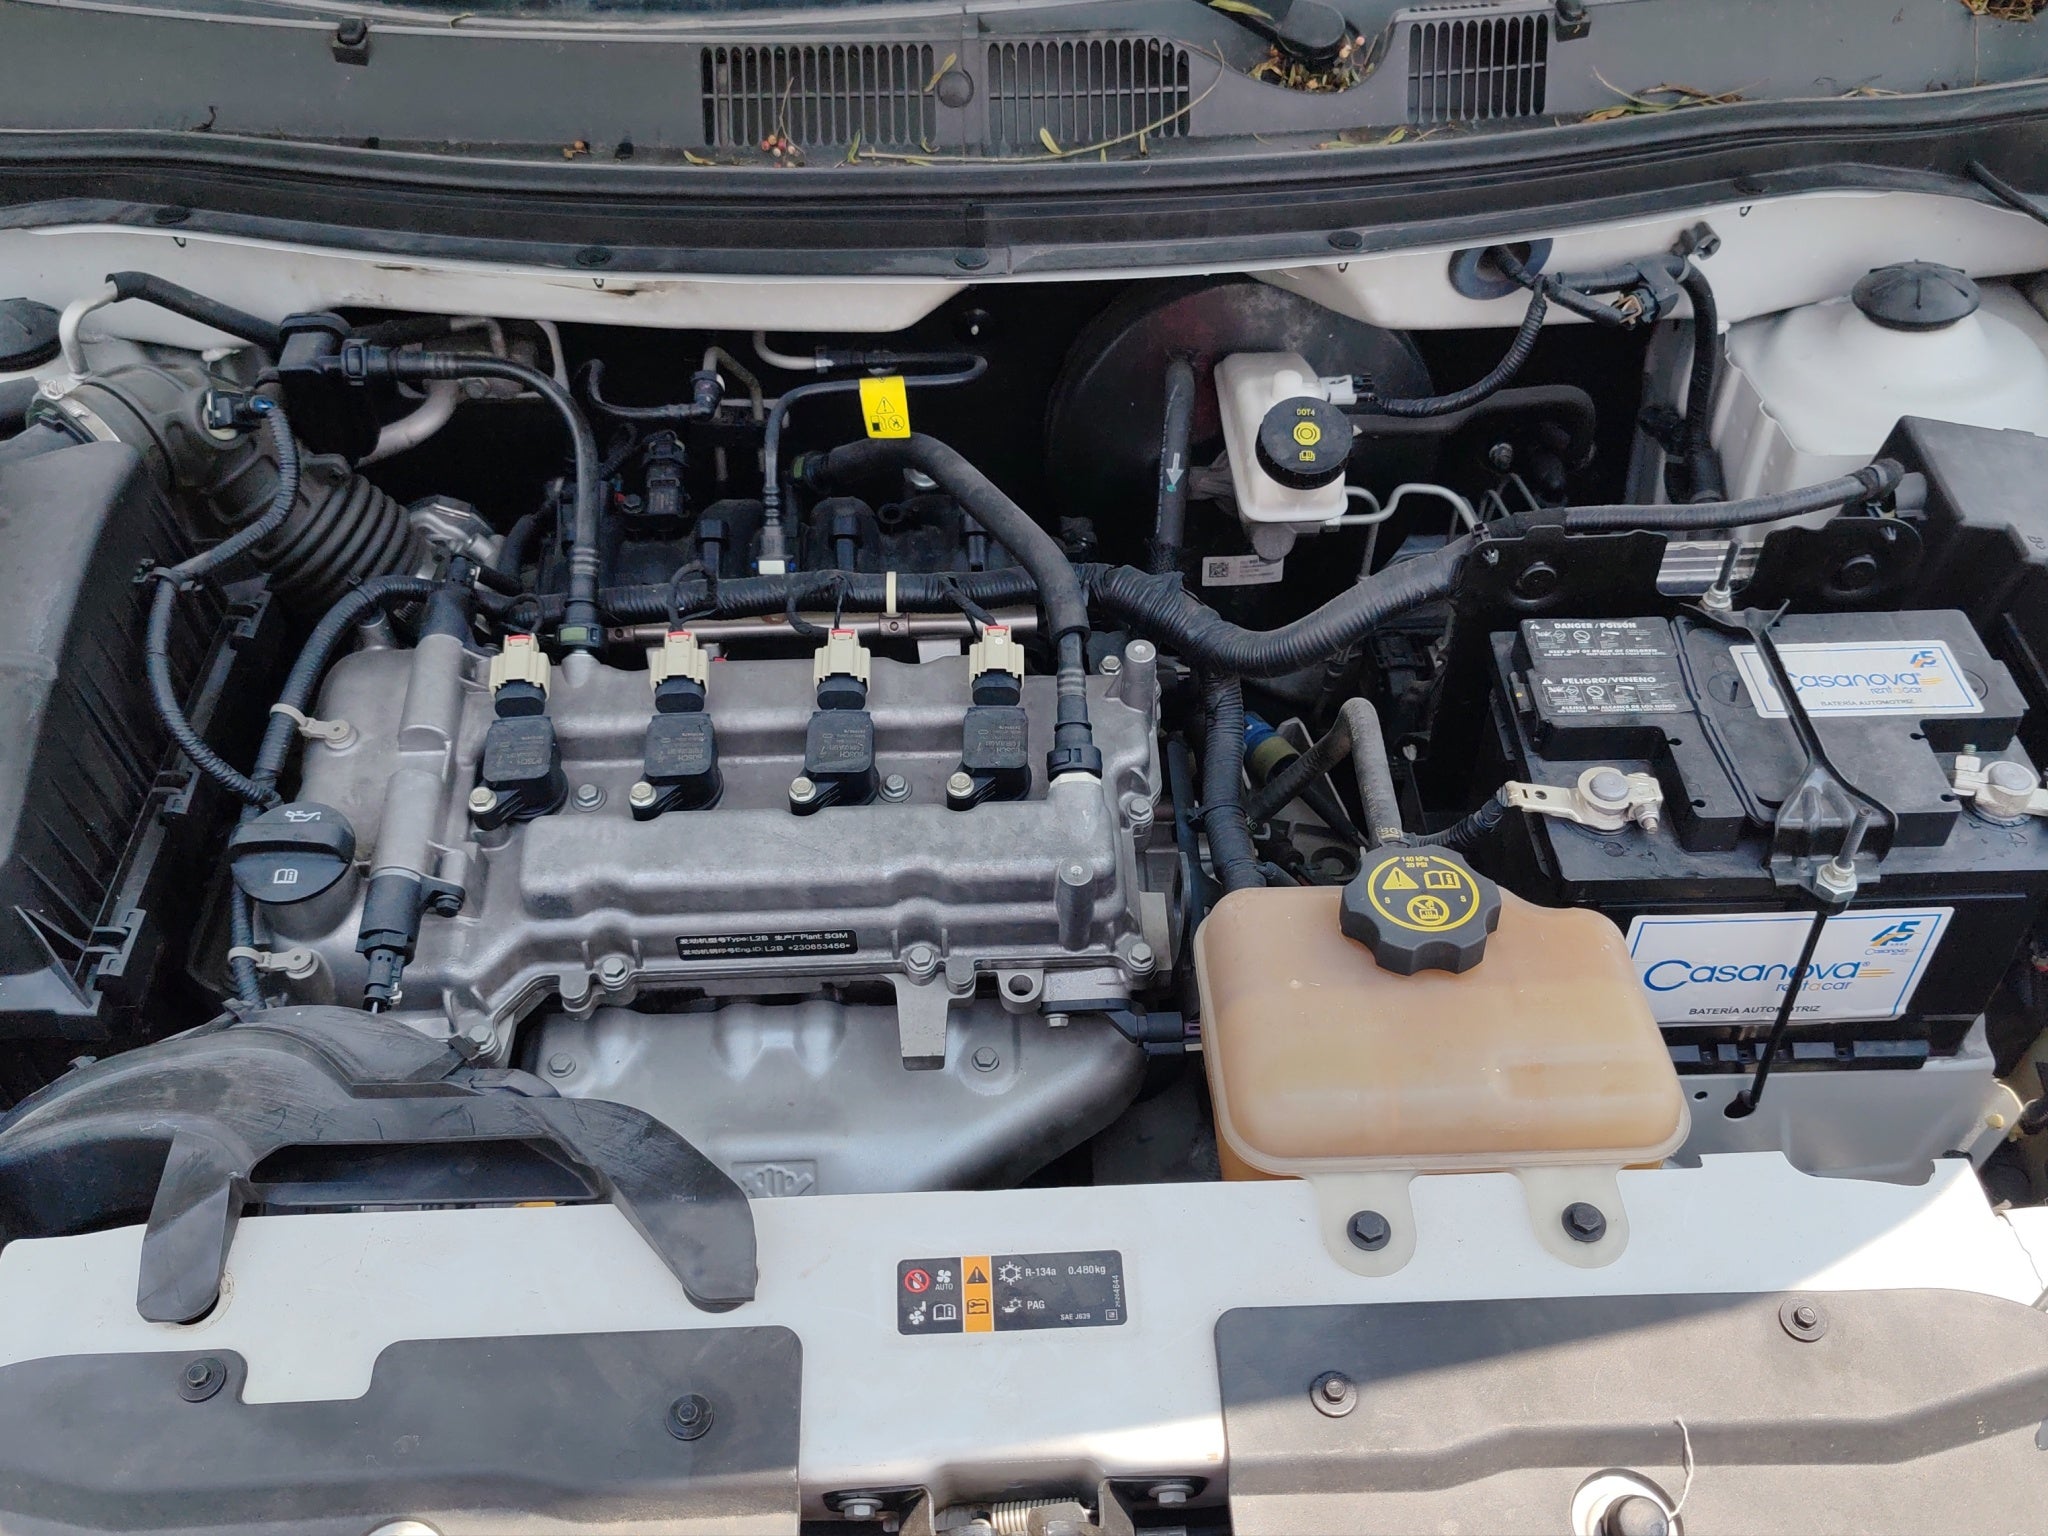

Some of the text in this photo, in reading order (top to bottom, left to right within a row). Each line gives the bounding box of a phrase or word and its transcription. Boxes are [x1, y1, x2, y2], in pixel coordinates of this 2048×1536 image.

[1296, 408, 1316, 416] DOT4
[824, 931, 848, 939] SGM
[1688, 1005, 1742, 1015] BATERÍA
[1025, 1268, 1057, 1277] R-134a
[935, 1283, 954, 1291] AUTO
[1027, 1300, 1046, 1310] PAG
[1060, 1313, 1074, 1321] SAE
